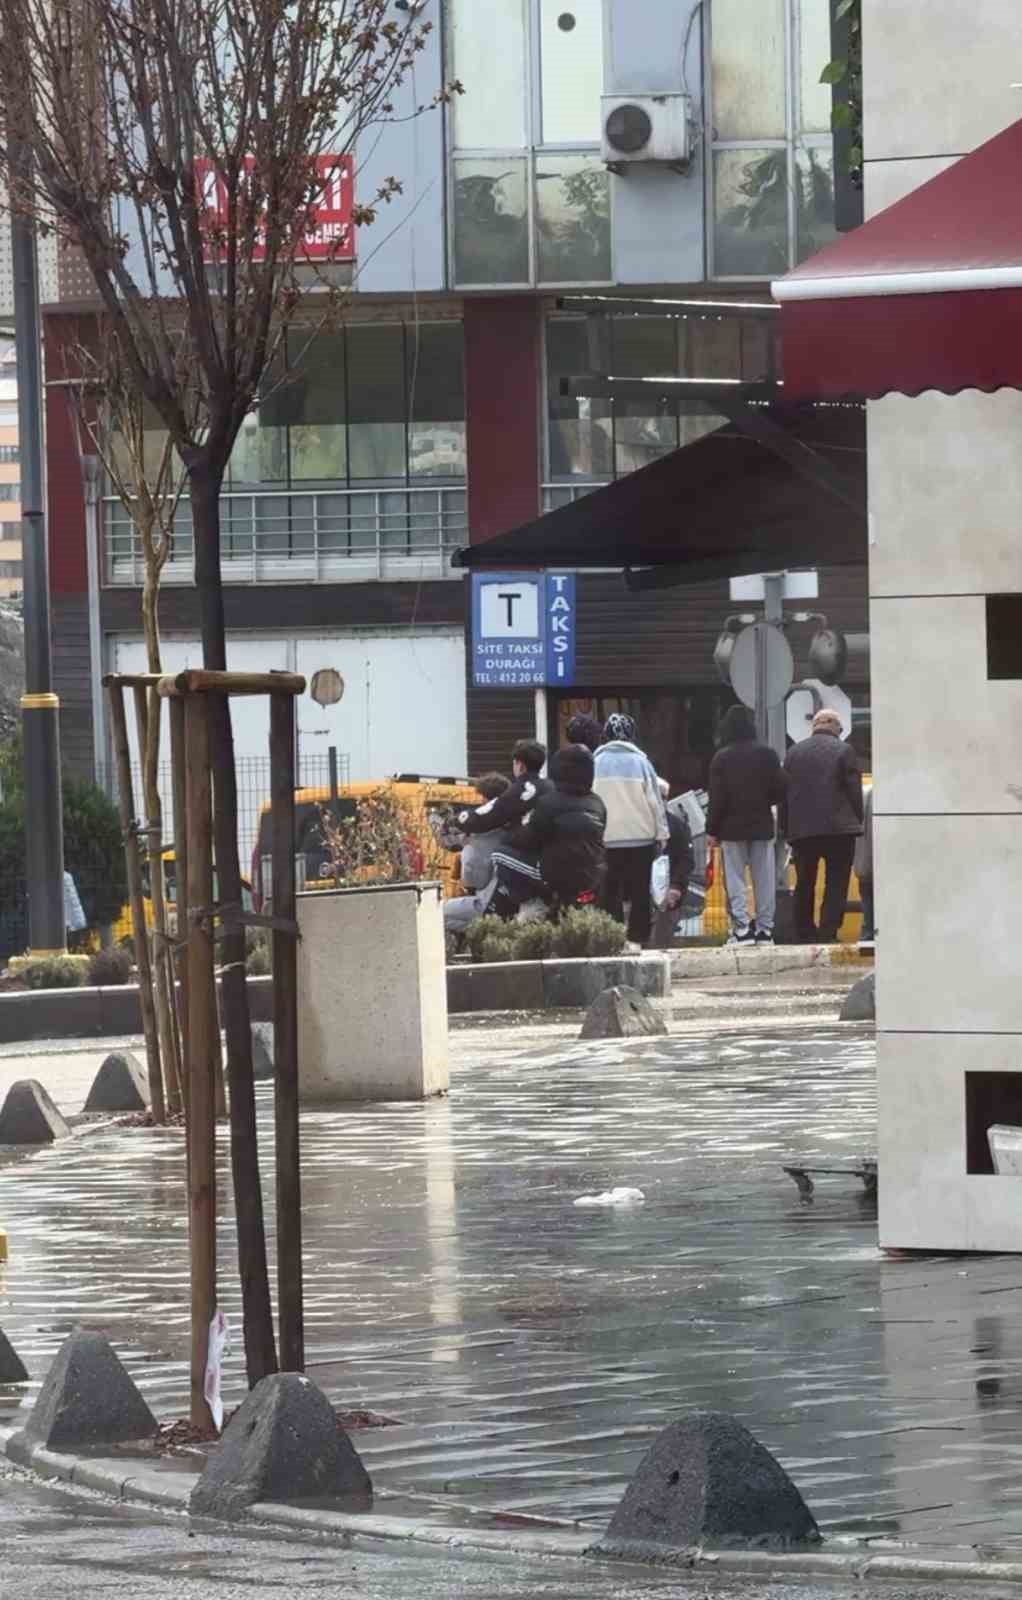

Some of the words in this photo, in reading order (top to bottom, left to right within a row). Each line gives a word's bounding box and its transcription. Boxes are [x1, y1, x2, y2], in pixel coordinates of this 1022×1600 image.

[498, 594, 522, 627] T
[550, 576, 570, 677] TAKSİ
[477, 642, 503, 655] SİTE
[507, 641, 543, 655] TAKSİ
[485, 657, 536, 669] DURAĞI
[499, 673, 516, 683] 412
[519, 672, 531, 683] 20
